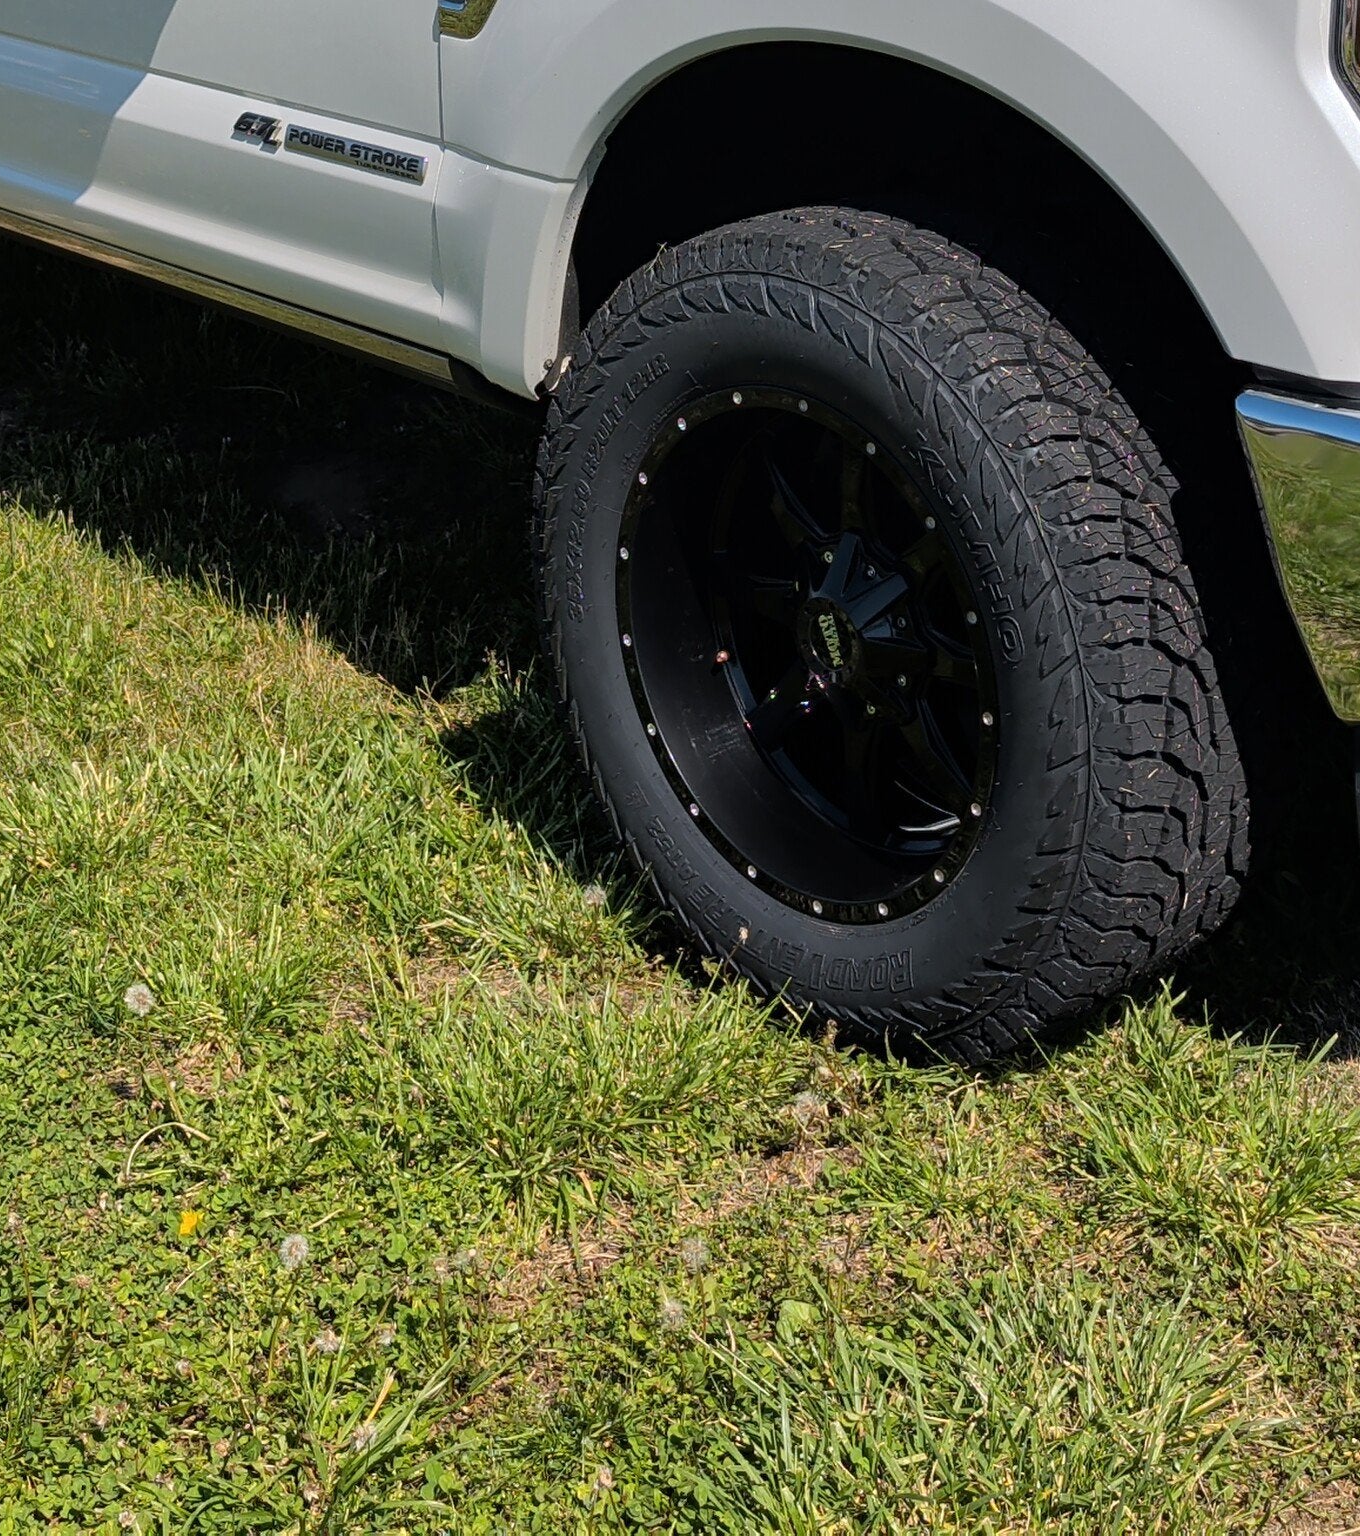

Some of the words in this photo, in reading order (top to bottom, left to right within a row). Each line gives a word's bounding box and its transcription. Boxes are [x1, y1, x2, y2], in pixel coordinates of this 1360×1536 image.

[288, 128, 346, 155] POWER
[349, 143, 420, 173] STROKE
[909, 429, 1026, 664] KUMHO
